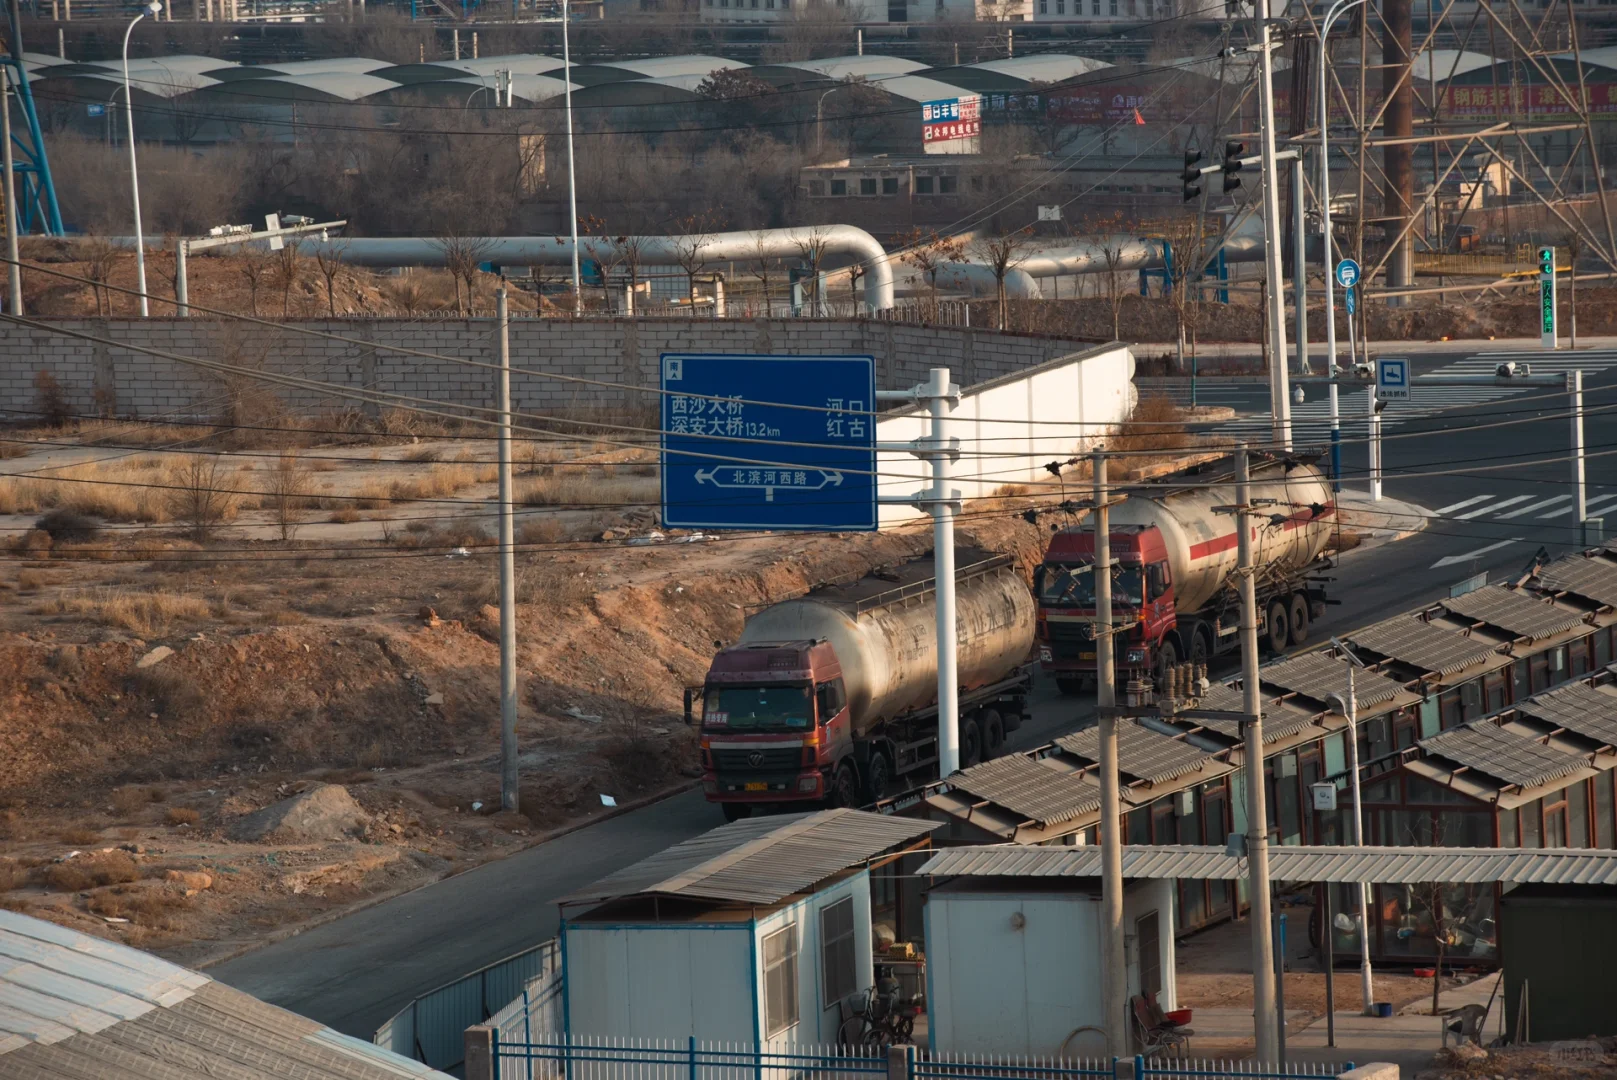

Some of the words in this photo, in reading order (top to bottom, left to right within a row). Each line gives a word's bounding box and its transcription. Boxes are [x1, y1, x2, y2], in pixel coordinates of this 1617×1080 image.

[1542, 280, 1553, 333] 行人安全通行
[669, 361, 679, 371] 南
[671, 395, 744, 415] 西沙大桥
[826, 397, 864, 417] 河口
[671, 416, 744, 436] 深安大桥
[745, 423, 781, 437] 13.2km
[826, 418, 865, 438] 红古
[733, 470, 807, 485] 北滨河西路
